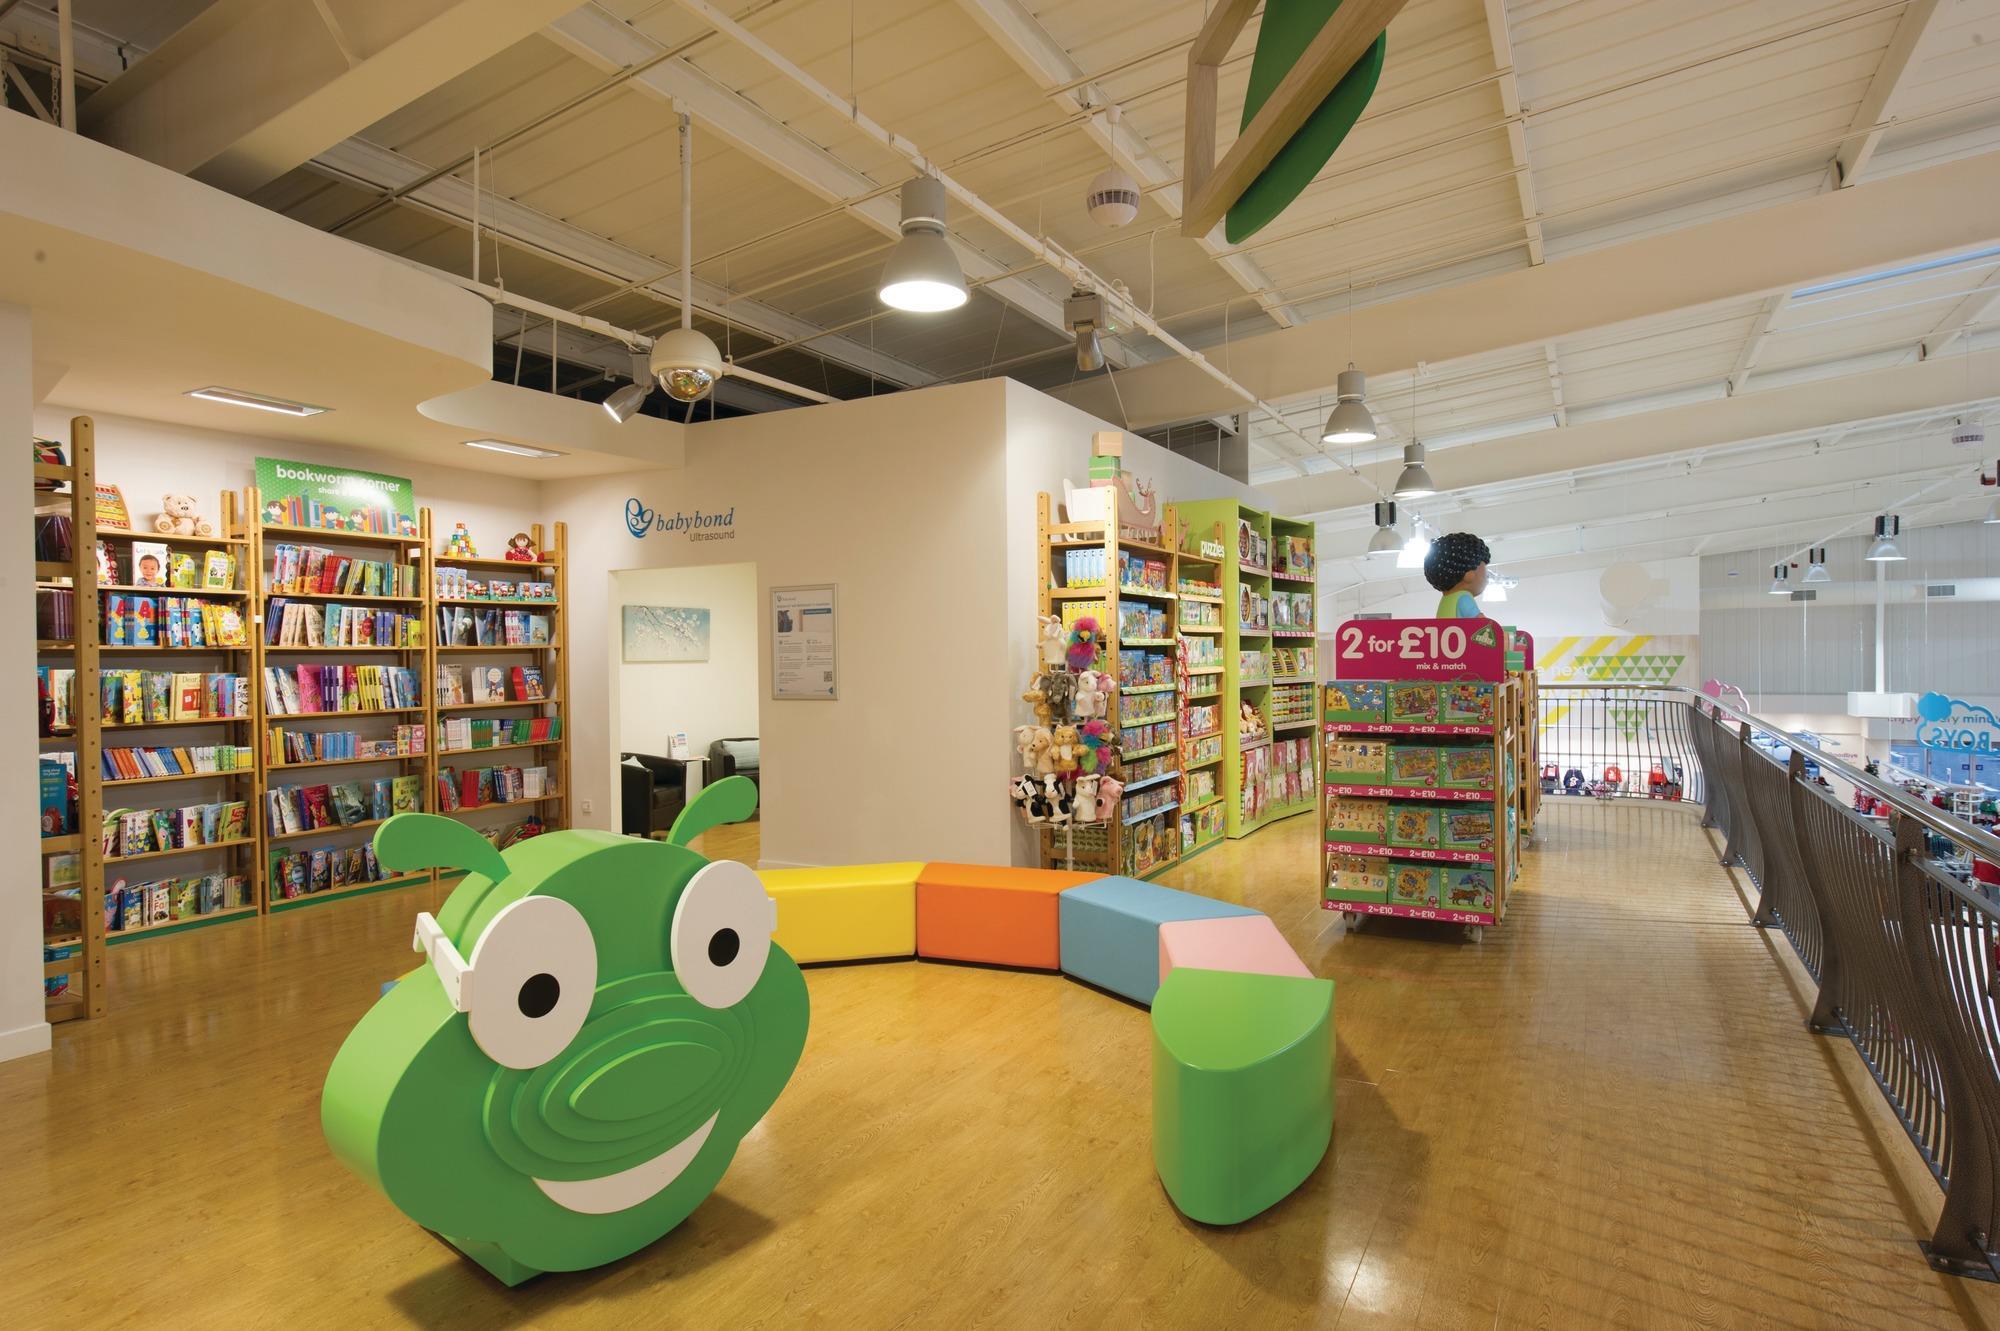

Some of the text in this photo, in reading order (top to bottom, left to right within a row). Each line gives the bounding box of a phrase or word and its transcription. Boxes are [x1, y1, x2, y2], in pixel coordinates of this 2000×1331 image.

[656, 507, 734, 534] babybond
[690, 530, 735, 542] Ultrasound
[1200, 539, 1224, 558] puzzles
[1342, 626, 1467, 660] 2 for £10
[1416, 662, 1467, 670] mix & match
[1465, 915, 1479, 923] £10
